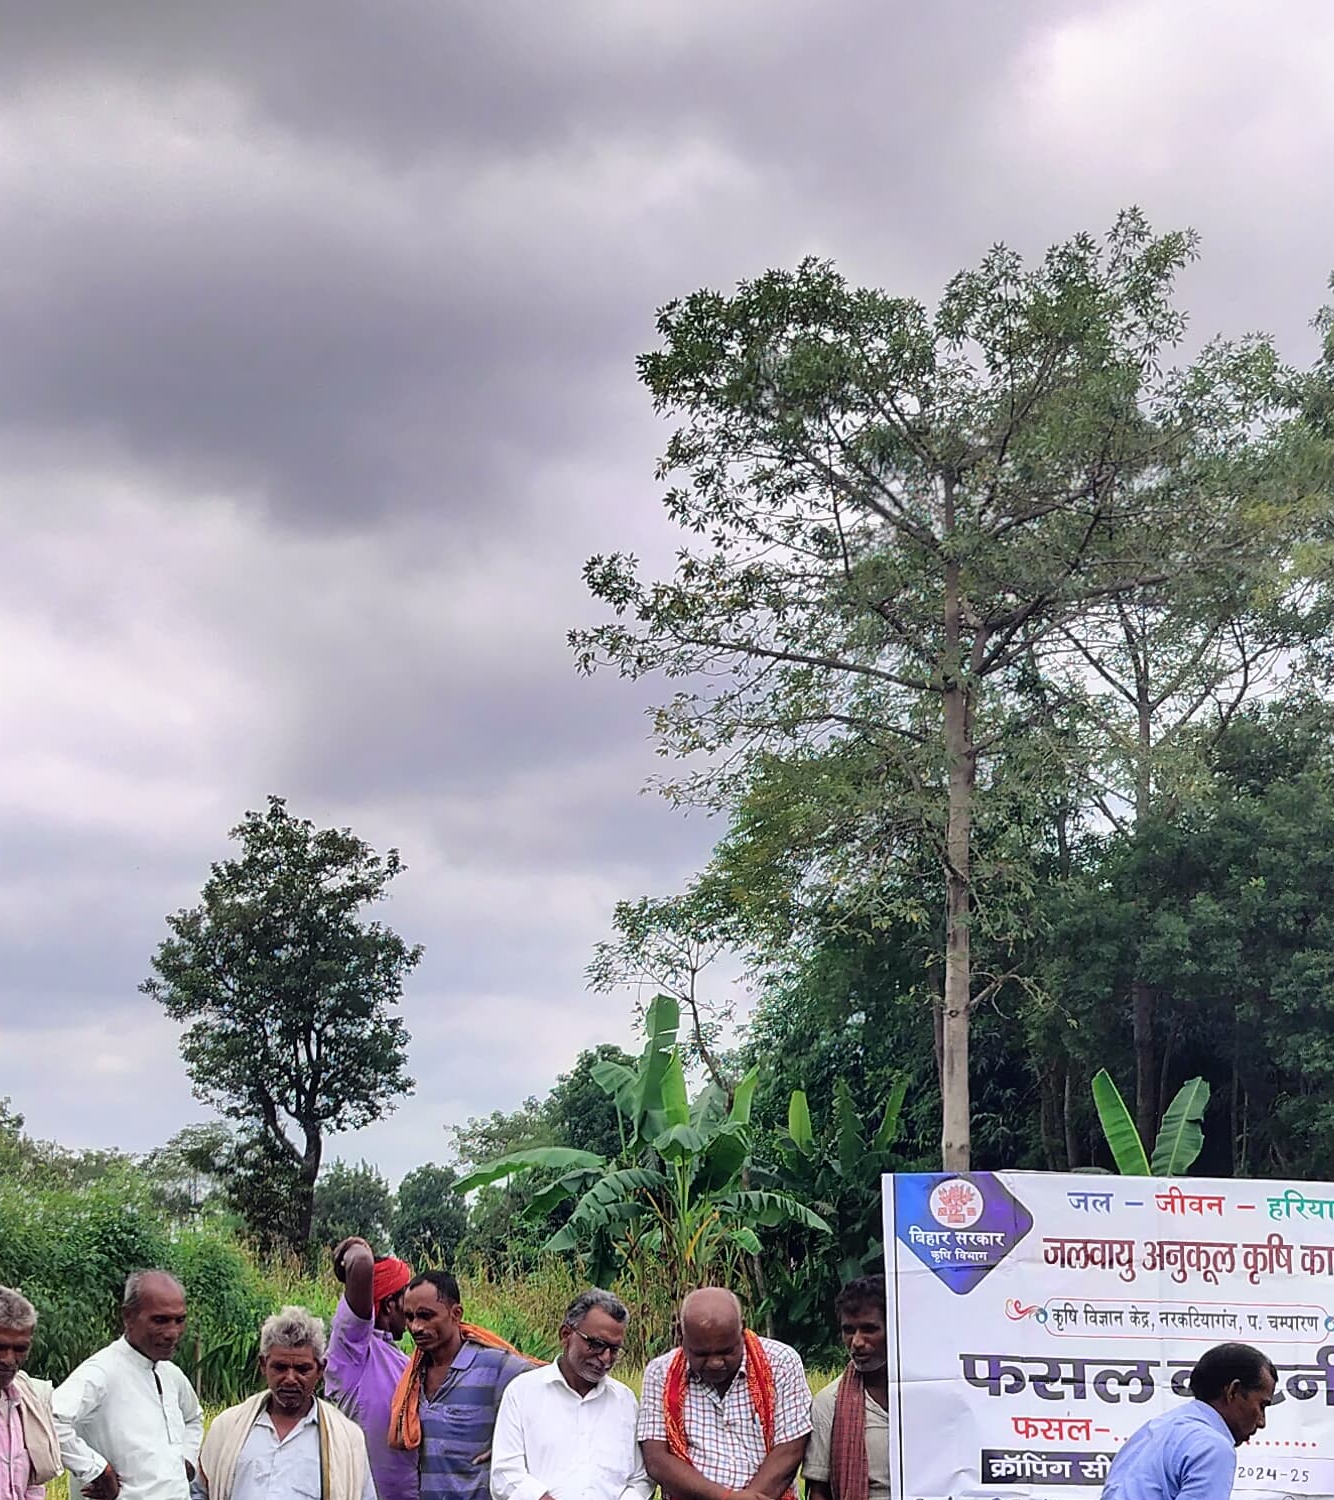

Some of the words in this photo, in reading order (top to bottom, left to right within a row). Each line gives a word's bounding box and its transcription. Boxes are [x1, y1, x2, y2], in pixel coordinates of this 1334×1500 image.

[1067, 1192, 1114, 1213] जल
[1155, 1186, 1226, 1216] जीवन
[955, 1232, 1005, 1247] सरकार
[1043, 1238, 1136, 1282] जलवायु
[1142, 1240, 1237, 1285] अनुकूल
[1243, 1233, 1294, 1284] कृषि
[1052, 1303, 1078, 1331] कृषि
[1083, 1304, 1124, 1326] विज्ञान
[1159, 1306, 1242, 1334] नरकटियागंज,
[1267, 1315, 1320, 1332] चम्पारण
[959, 1354, 1161, 1403] फसल
[989, 1453, 1072, 1478] क्रॉपिंग
[1238, 1466, 1310, 1483] 2024-25
